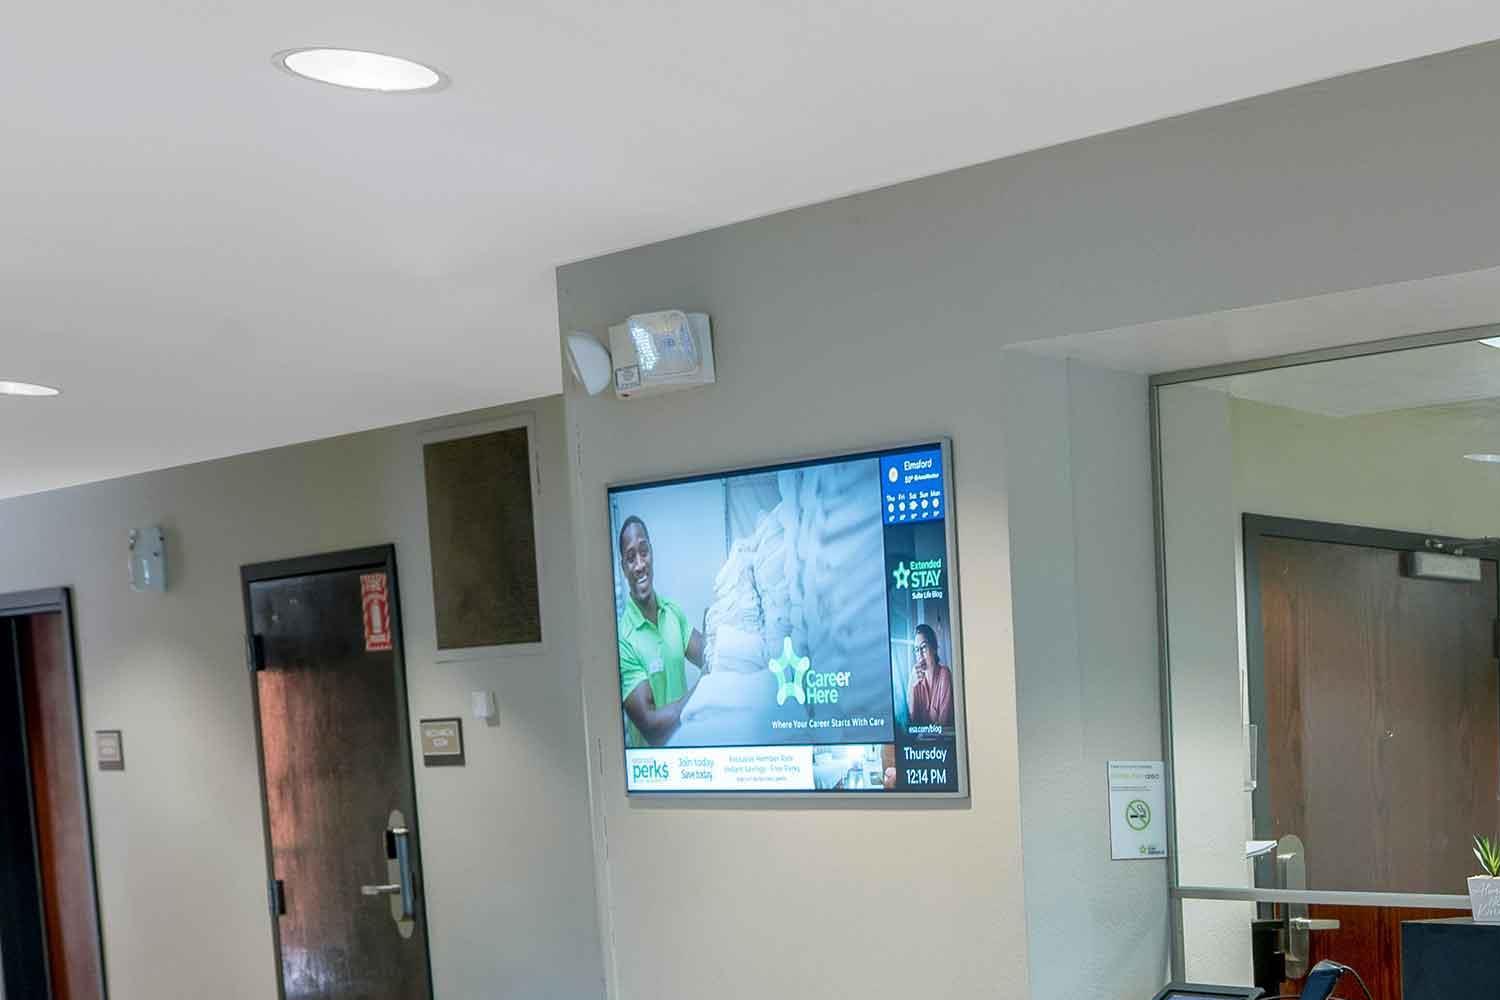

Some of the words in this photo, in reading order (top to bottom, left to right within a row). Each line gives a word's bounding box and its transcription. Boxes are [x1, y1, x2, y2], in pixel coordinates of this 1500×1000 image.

[904, 458, 932, 471] Elmsford
[910, 558, 941, 570] Extended
[911, 570, 941, 588] STAY
[806, 669, 851, 688] Career
[807, 687, 839, 705] Here
[772, 719, 792, 729] Where
[793, 719, 807, 729] Your
[809, 719, 830, 728] Career
[831, 718, 850, 728] Starts
[851, 717, 868, 727] With
[869, 717, 885, 727] Care
[904, 746, 947, 763] Thursday
[632, 759, 669, 784] perks
[906, 768, 928, 785] 12:14
[930, 768, 947, 785] PM
